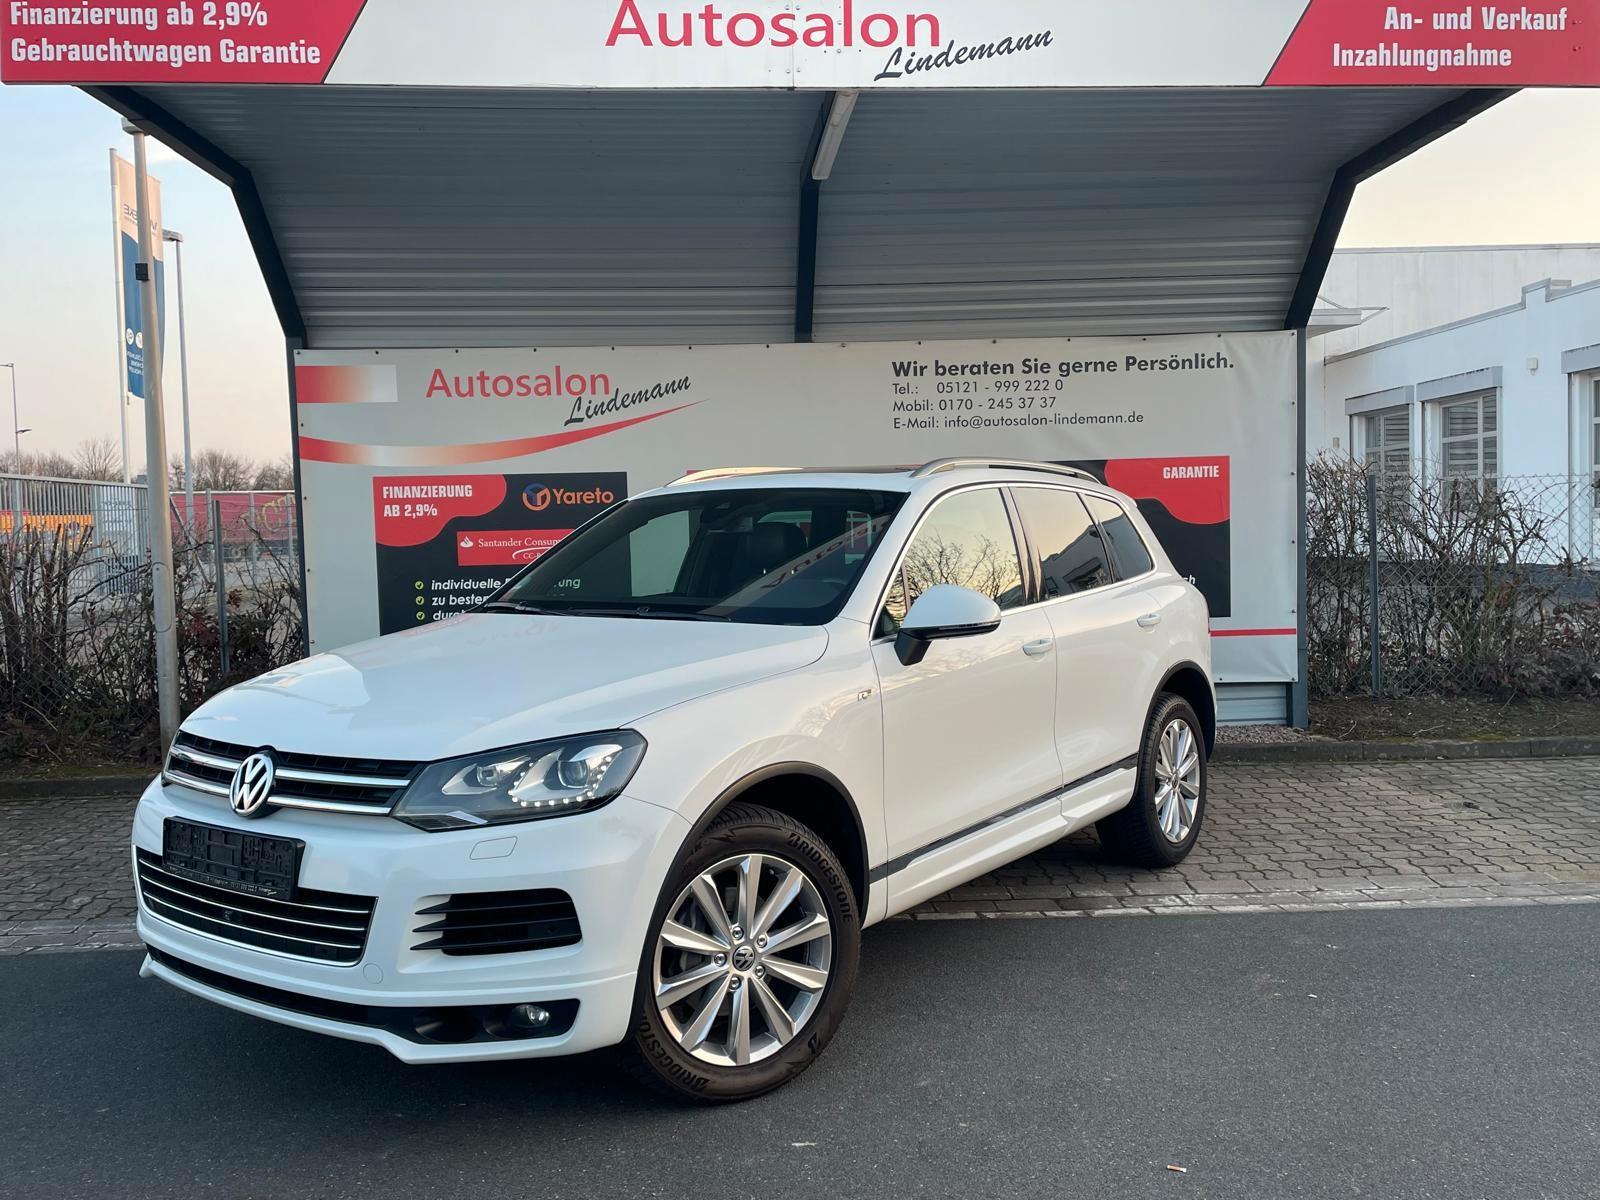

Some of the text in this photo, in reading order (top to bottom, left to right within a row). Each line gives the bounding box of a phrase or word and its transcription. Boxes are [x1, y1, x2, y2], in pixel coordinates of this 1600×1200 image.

[11, 1, 268, 31] Finanzierung ab 2,9%
[605, 0, 941, 48] Autosalon
[1384, 6, 1568, 31] An- und Verkauf
[11, 37, 321, 68] Gebrauchtwagen Garantie
[873, 29, 1054, 82] Lindemann
[1333, 42, 1513, 72] Inzahlungnahme
[891, 351, 1235, 378] Wir beraten Sie gerne Persönlich.
[425, 365, 611, 398] Autosalon
[892, 382, 919, 395] Tel.:
[936, 381, 979, 394] 05121
[994, 379, 1020, 393] 999
[1024, 379, 1050, 392] 222
[1054, 378, 1064, 391] 0
[563, 375, 691, 427] Lindemann
[892, 399, 934, 412] Mobil:
[938, 398, 973, 411] 0170
[987, 397, 1014, 410] 245
[1018, 397, 1035, 409] 37
[1039, 396, 1057, 409] 37
[893, 411, 1144, 429] E-Mail: info@autosalon-lindemann.de
[1163, 466, 1219, 480] GARANTIE
[382, 484, 473, 499] FINANZIERUNG
[552, 487, 615, 505] Yareto
[383, 503, 438, 519] AB 2,9%
[478, 537, 523, 548] Santander
[431, 578, 501, 590] individuelle
[431, 597, 446, 606] zu
[432, 609, 466, 621] dur
[787, 832, 854, 923] BRIDGESTONE
